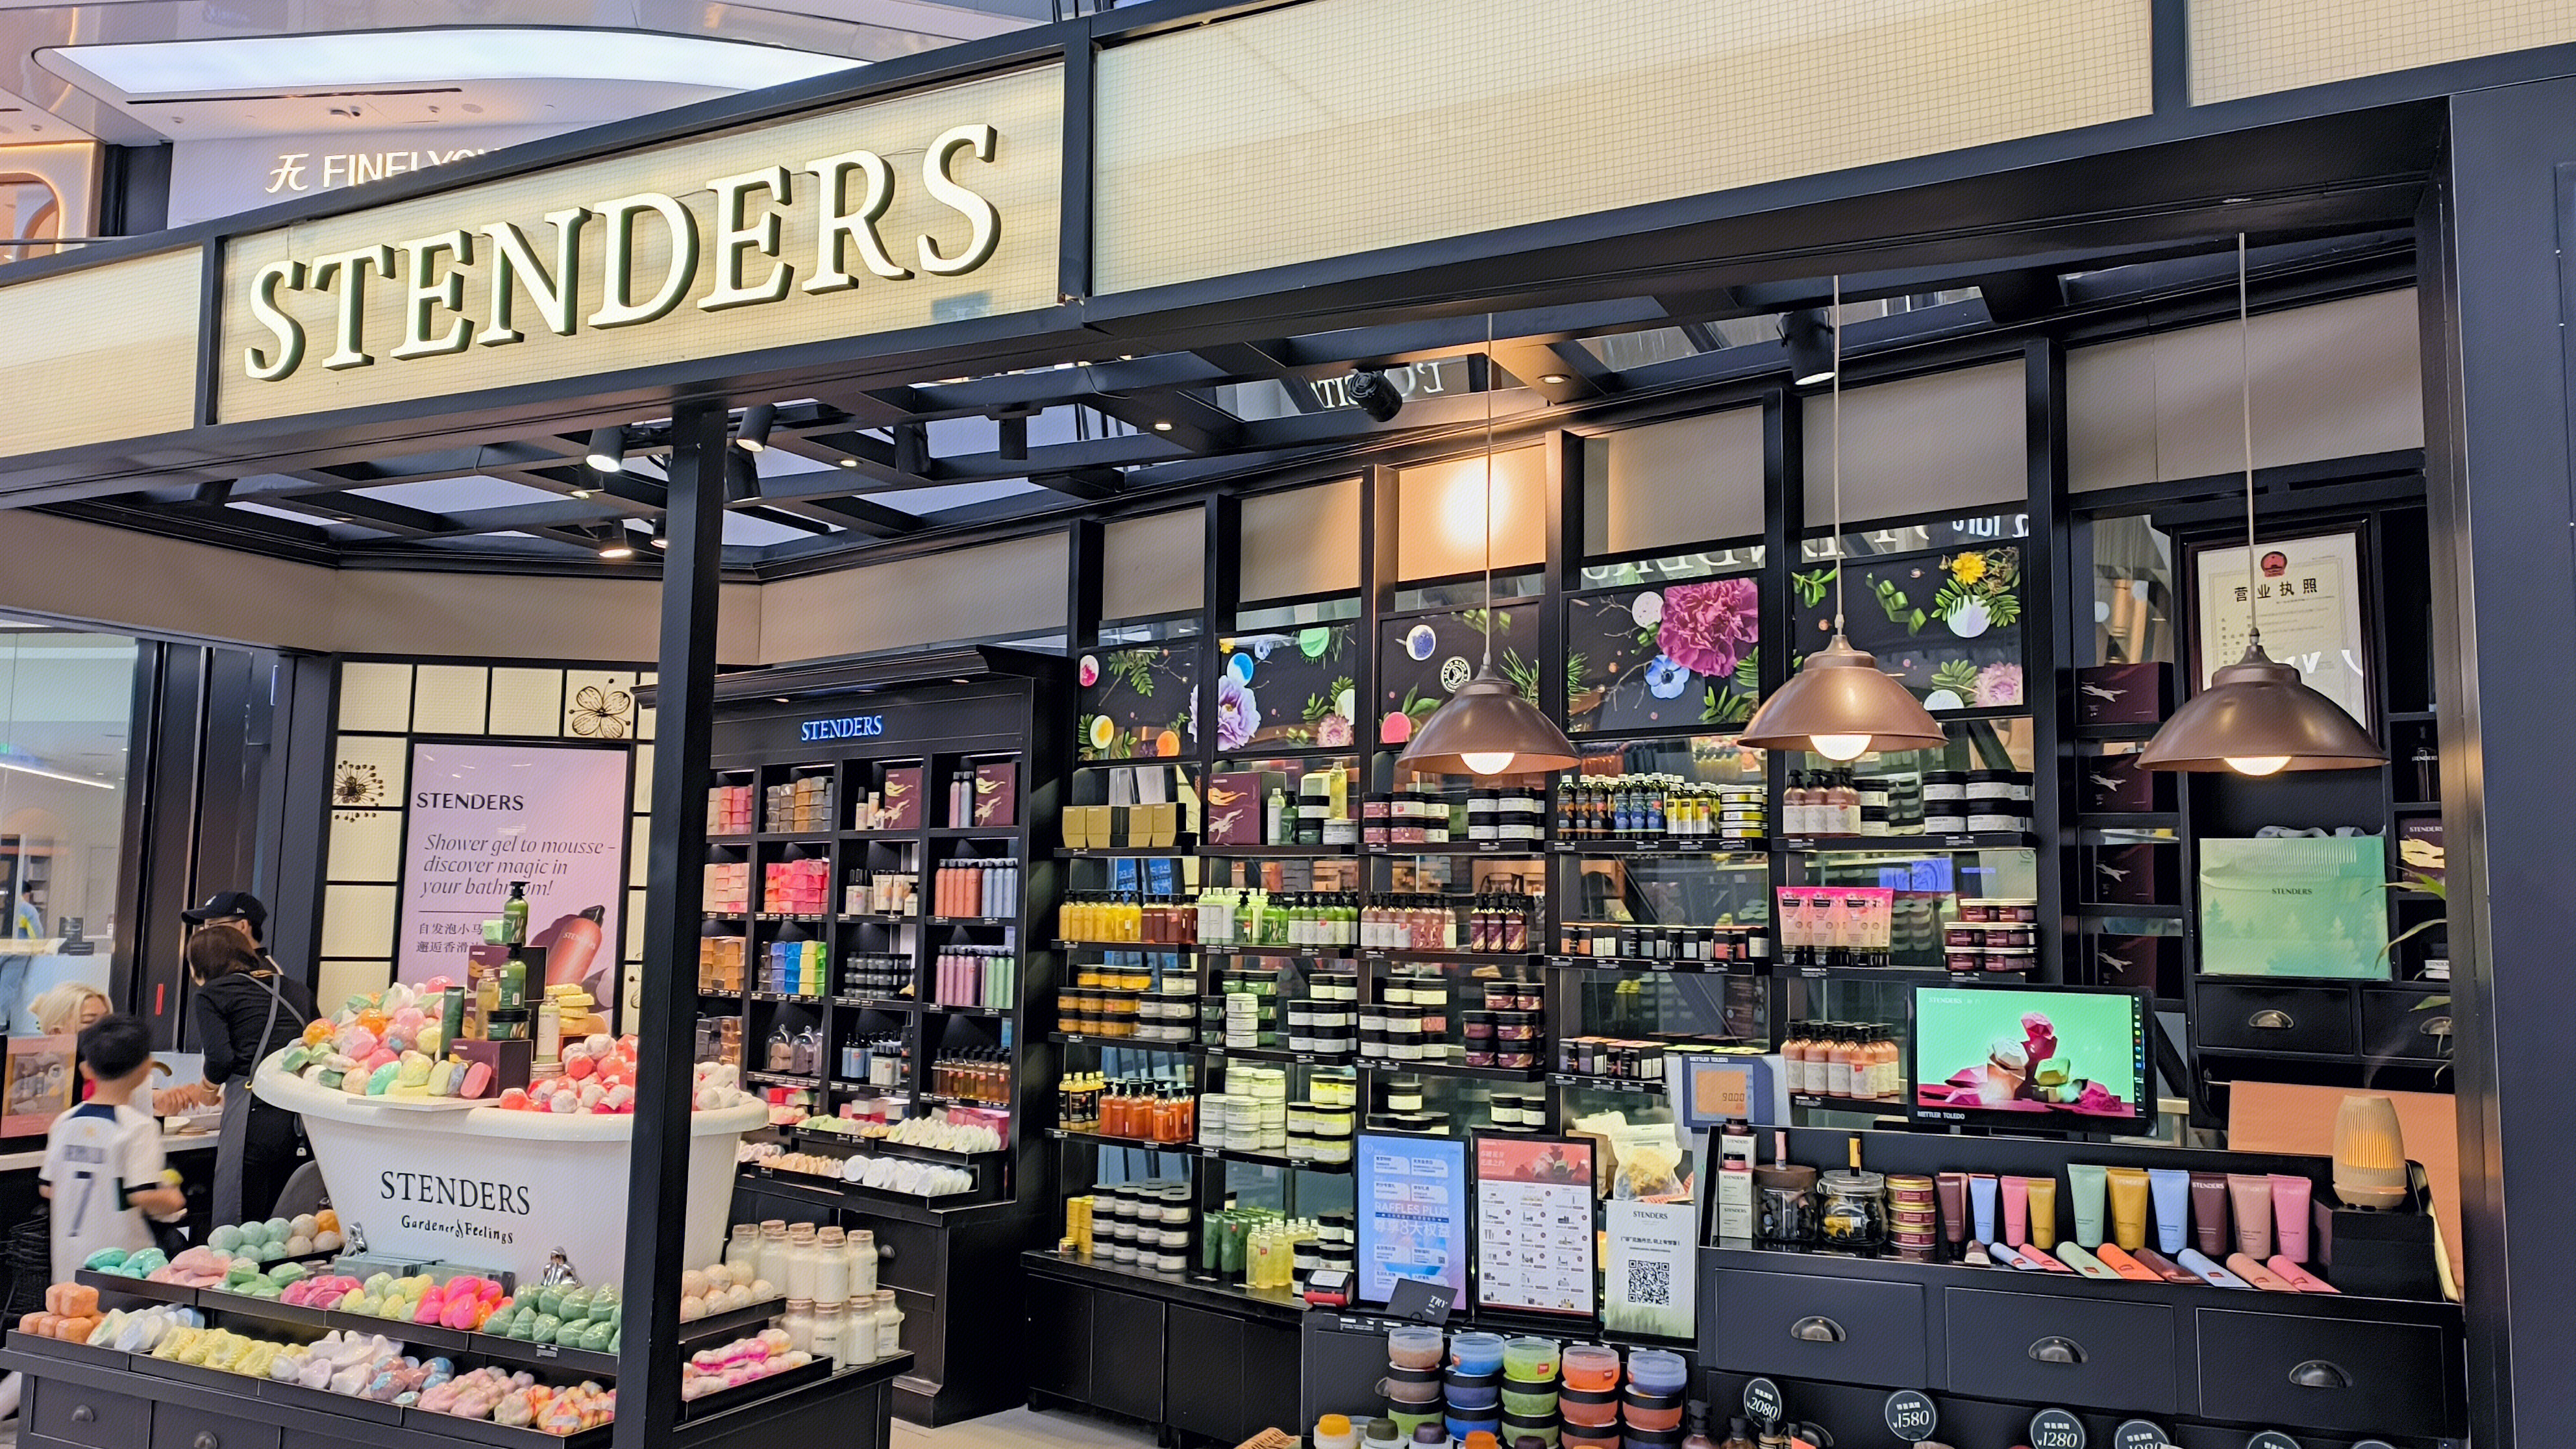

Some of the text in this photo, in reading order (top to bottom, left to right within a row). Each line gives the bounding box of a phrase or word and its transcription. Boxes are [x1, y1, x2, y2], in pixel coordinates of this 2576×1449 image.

[244, 123, 1001, 382] STENDERS
[2235, 578, 2318, 602] 营业执照
[801, 715, 883, 741] STENDERS
[416, 792, 525, 811] STENDERS
[424, 834, 488, 852] Shower
[490, 836, 518, 857] gel
[520, 839, 538, 853] to
[541, 841, 604, 854] mousse
[423, 855, 567, 879] discover magic in
[419, 880, 462, 898] your
[1943, 1111, 1965, 1120] TOLEDO
[380, 1170, 530, 1215] STENDERS
[1374, 1202, 1450, 1217] RAFFLES PLUS
[1633, 1211, 1668, 1220] STENDERS
[401, 1215, 454, 1233] Gardener
[465, 1222, 514, 1245] Feelings
